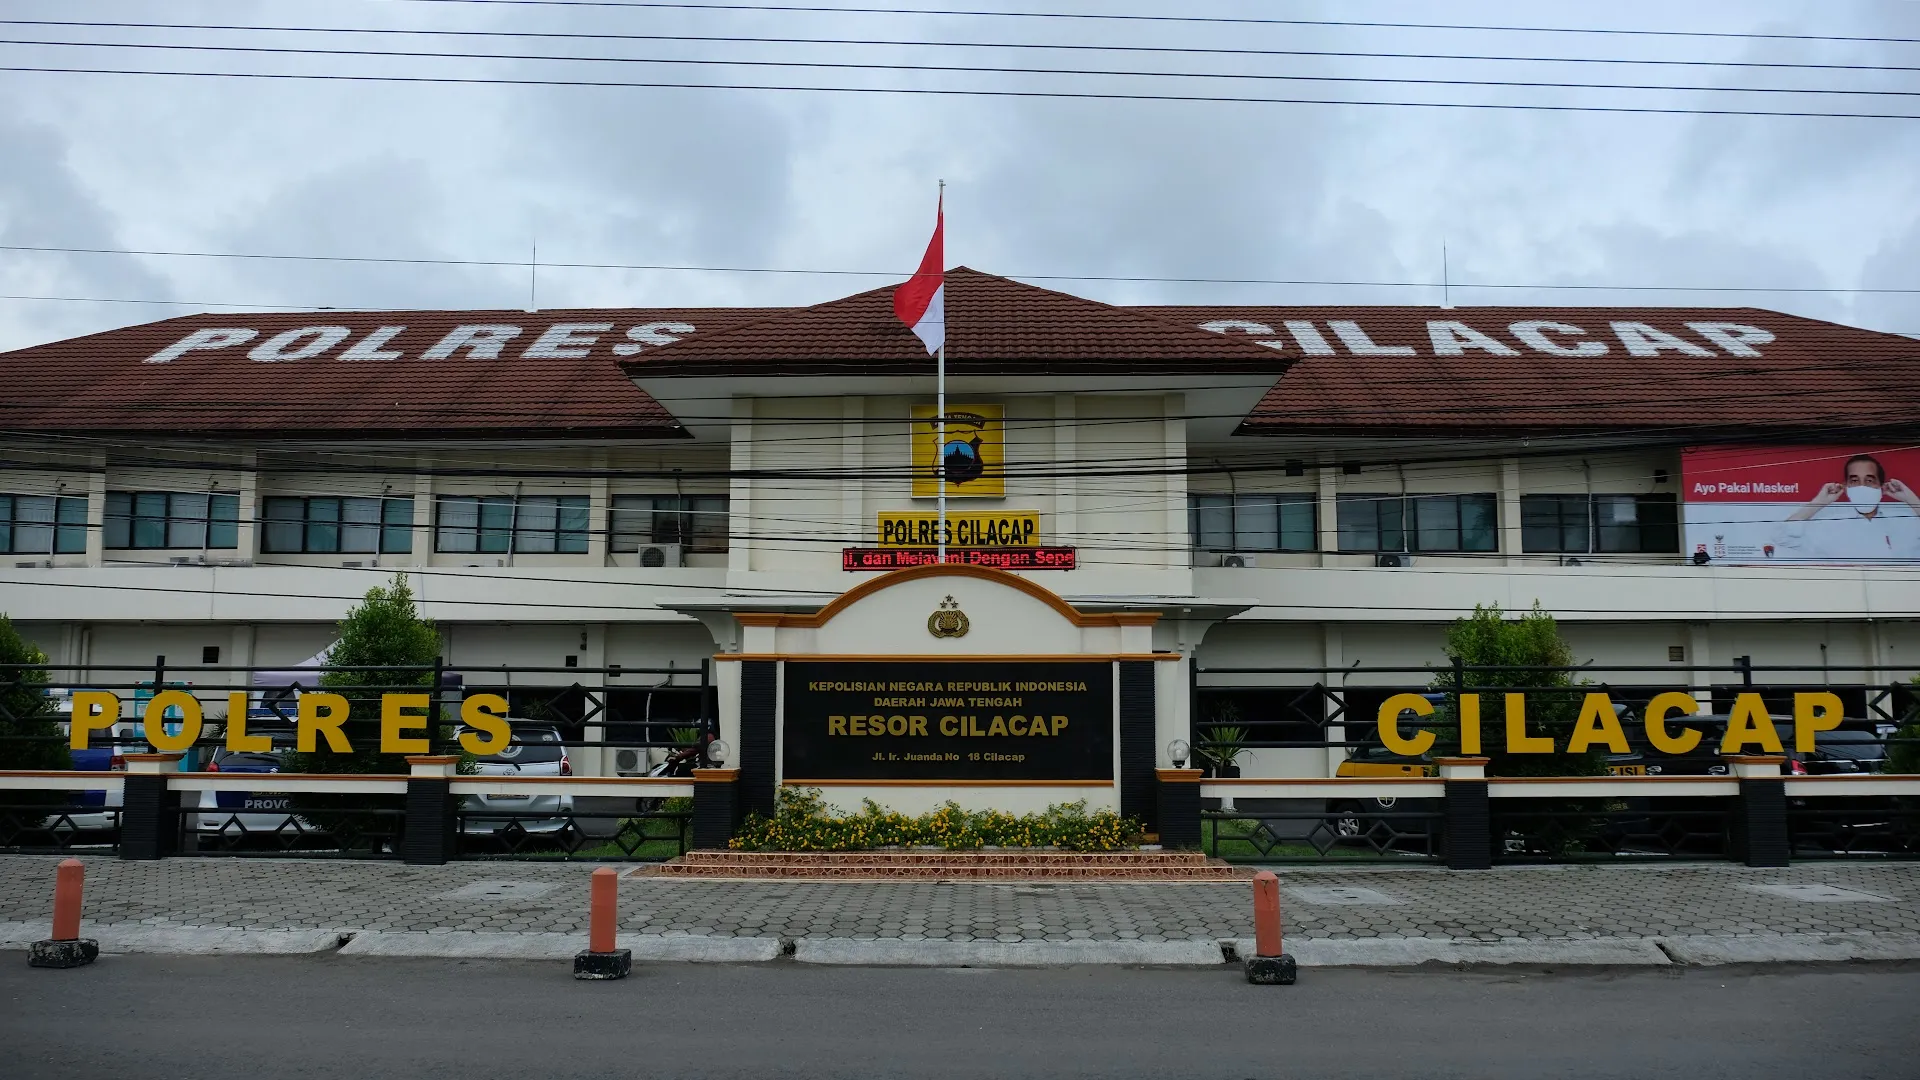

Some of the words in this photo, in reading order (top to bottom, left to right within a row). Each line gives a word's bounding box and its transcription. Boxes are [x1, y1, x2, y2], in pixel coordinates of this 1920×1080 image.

[142, 321, 696, 363] POLRES
[1693, 482, 1717, 496] Ayo
[1718, 482, 1751, 494] Pakai
[1752, 482, 1800, 494] Masker!
[883, 519, 952, 546] POLRES
[957, 518, 1035, 545] CILACAP
[862, 552, 892, 565] dan
[969, 551, 1030, 566] Dengan
[809, 681, 886, 692] KEPOLISIAN
[889, 681, 944, 692] NEGARA
[947, 681, 1011, 692] REPUBLIK
[1015, 681, 1087, 692] INDONESIA
[874, 697, 926, 707] DAERAH
[930, 697, 965, 707] JAWA
[969, 697, 1023, 707] TENGAH
[70, 690, 512, 755] POLRES
[828, 715, 929, 737] RESOR
[939, 715, 1069, 737] CILACAP
[1377, 691, 1845, 756] CILACAP
[872, 752, 885, 761] Jl.
[888, 752, 900, 761] Ir.
[903, 752, 943, 761] Juanda
[944, 752, 960, 761] No
[967, 752, 981, 761] 18
[983, 752, 1026, 763] Cilacap
